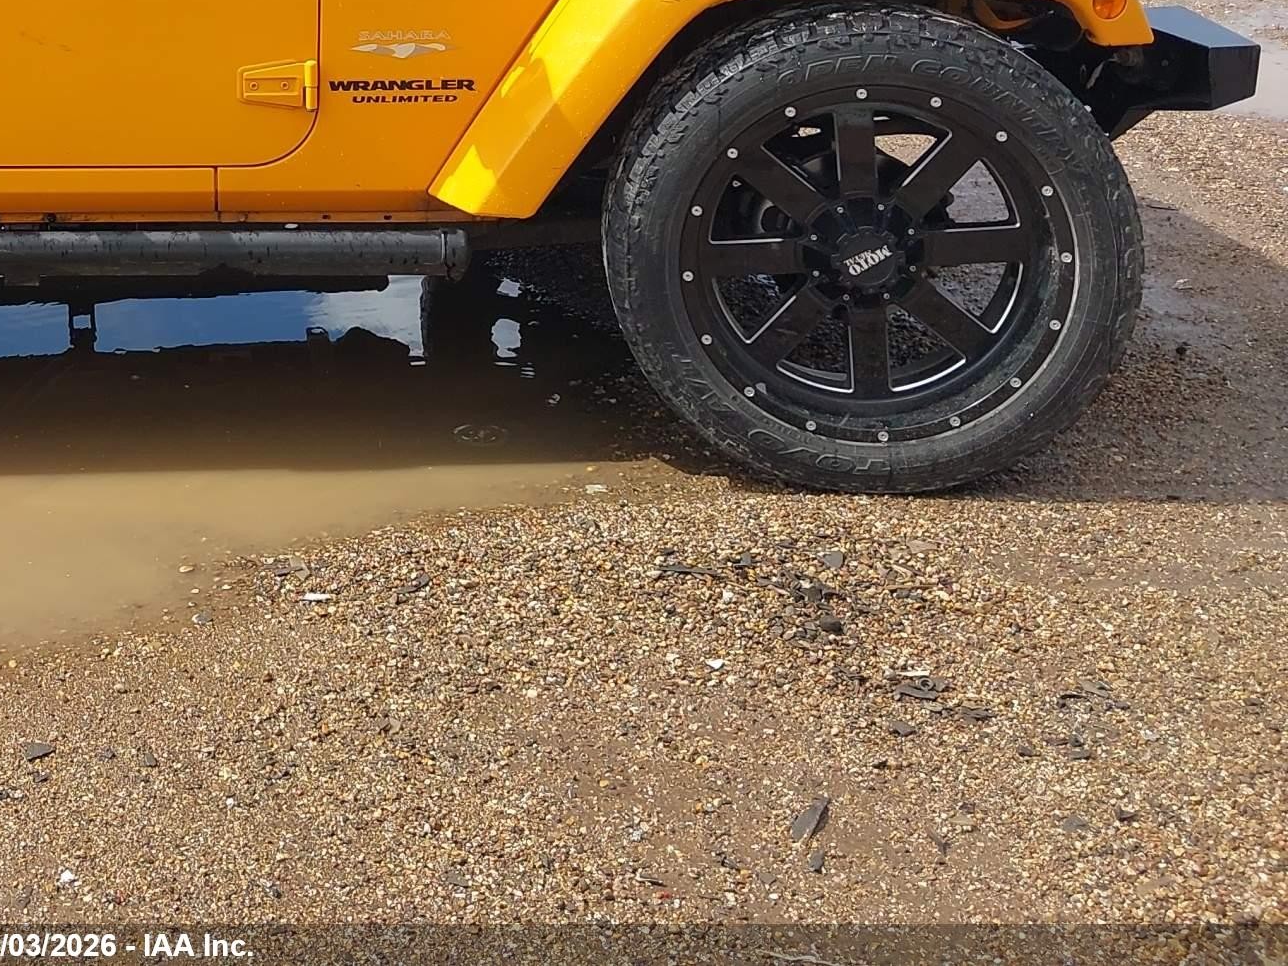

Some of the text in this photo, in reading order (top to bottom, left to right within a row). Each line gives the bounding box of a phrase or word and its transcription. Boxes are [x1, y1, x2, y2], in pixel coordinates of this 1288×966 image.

[358, 30, 451, 41] SAHARA
[777, 54, 898, 86] OPEN
[329, 79, 476, 91] WRANGLER
[352, 95, 458, 104] UNLIMITED
[848, 245, 893, 276] MOTO
[748, 428, 891, 475] TOYO
